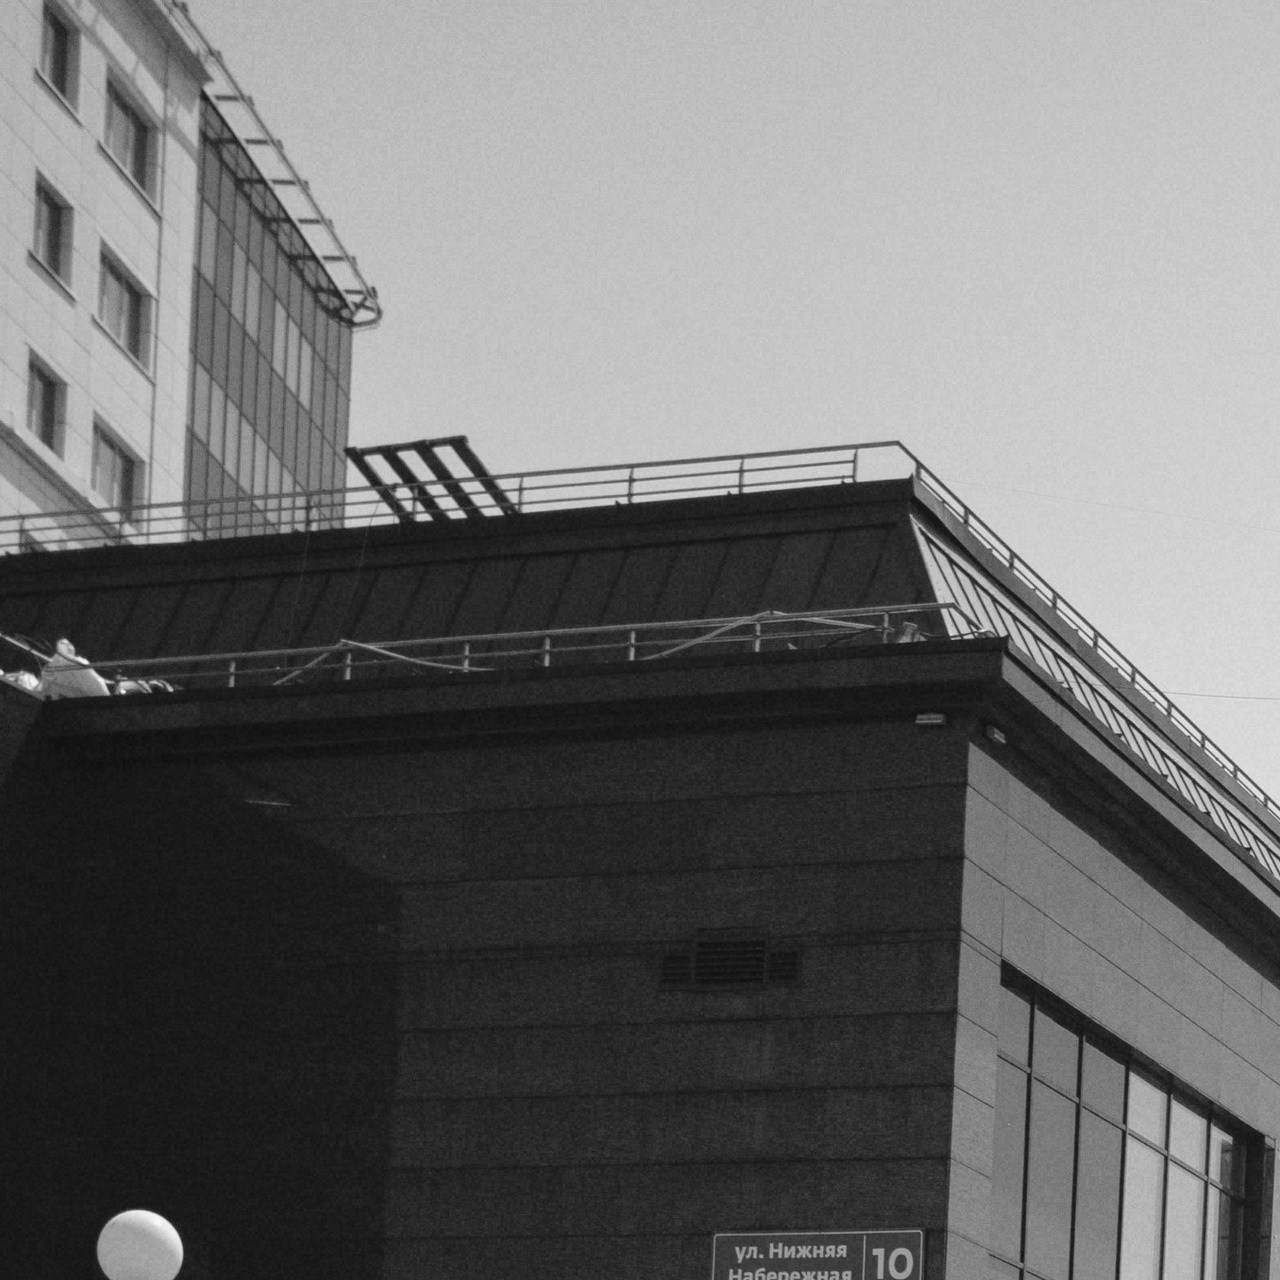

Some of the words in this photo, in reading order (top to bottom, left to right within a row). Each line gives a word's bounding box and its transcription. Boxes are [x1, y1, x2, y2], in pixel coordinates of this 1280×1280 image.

[734, 1245, 764, 1263] ул.
[768, 1242, 848, 1259] Нижняя
[872, 1247, 914, 1280] 10
